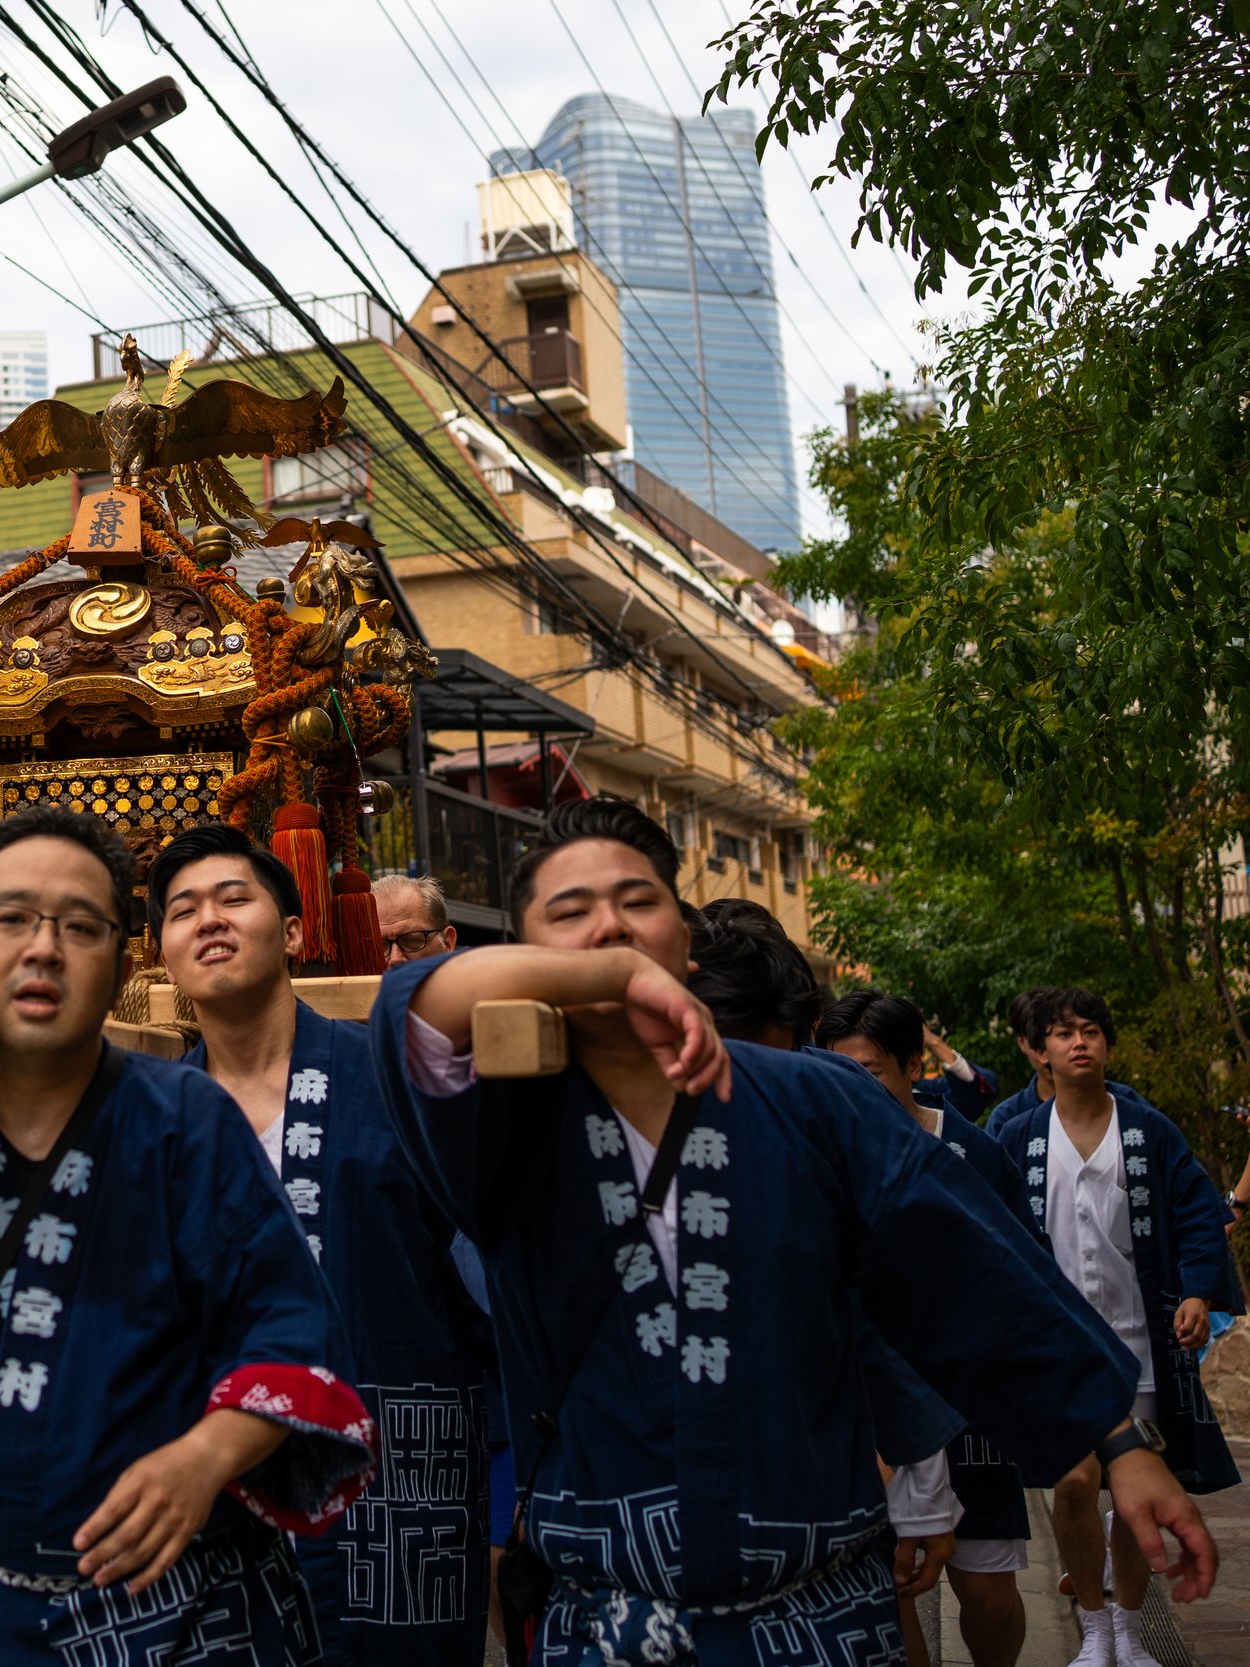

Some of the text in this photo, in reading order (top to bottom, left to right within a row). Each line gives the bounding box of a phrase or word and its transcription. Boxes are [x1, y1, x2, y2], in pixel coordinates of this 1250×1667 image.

[88, 497, 127, 549] 宮村町
[1026, 1136, 1047, 1233] 麻布宮
[1122, 1127, 1152, 1238] 麻布宮村
[679, 1126, 731, 1384] 麻布宮村
